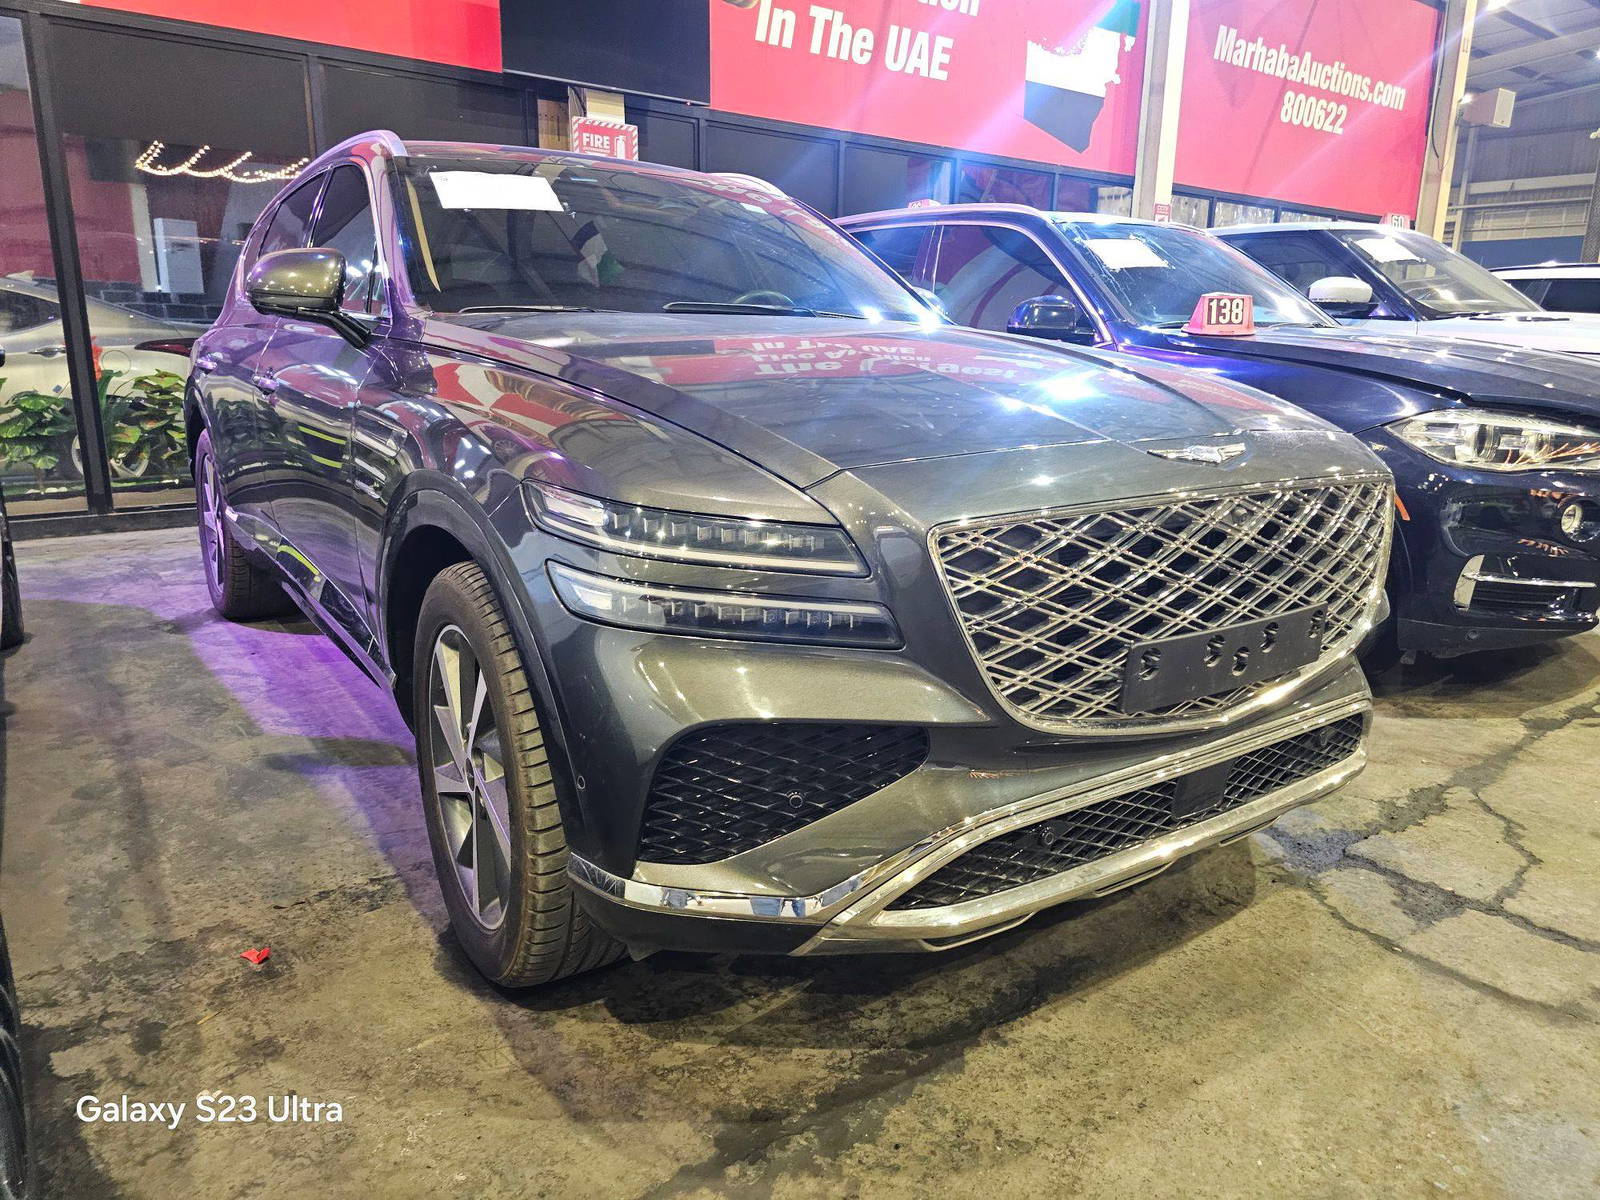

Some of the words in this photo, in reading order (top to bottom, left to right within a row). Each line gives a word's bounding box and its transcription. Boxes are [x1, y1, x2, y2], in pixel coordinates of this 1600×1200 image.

[754, 0, 797, 49] In
[809, 4, 874, 65] The
[884, 24, 954, 81] UAE
[1213, 24, 1407, 111] MarhabaAuctions.com
[1280, 90, 1348, 135] 800622
[582, 132, 611, 149] FIRE
[1209, 298, 1243, 325] 138
